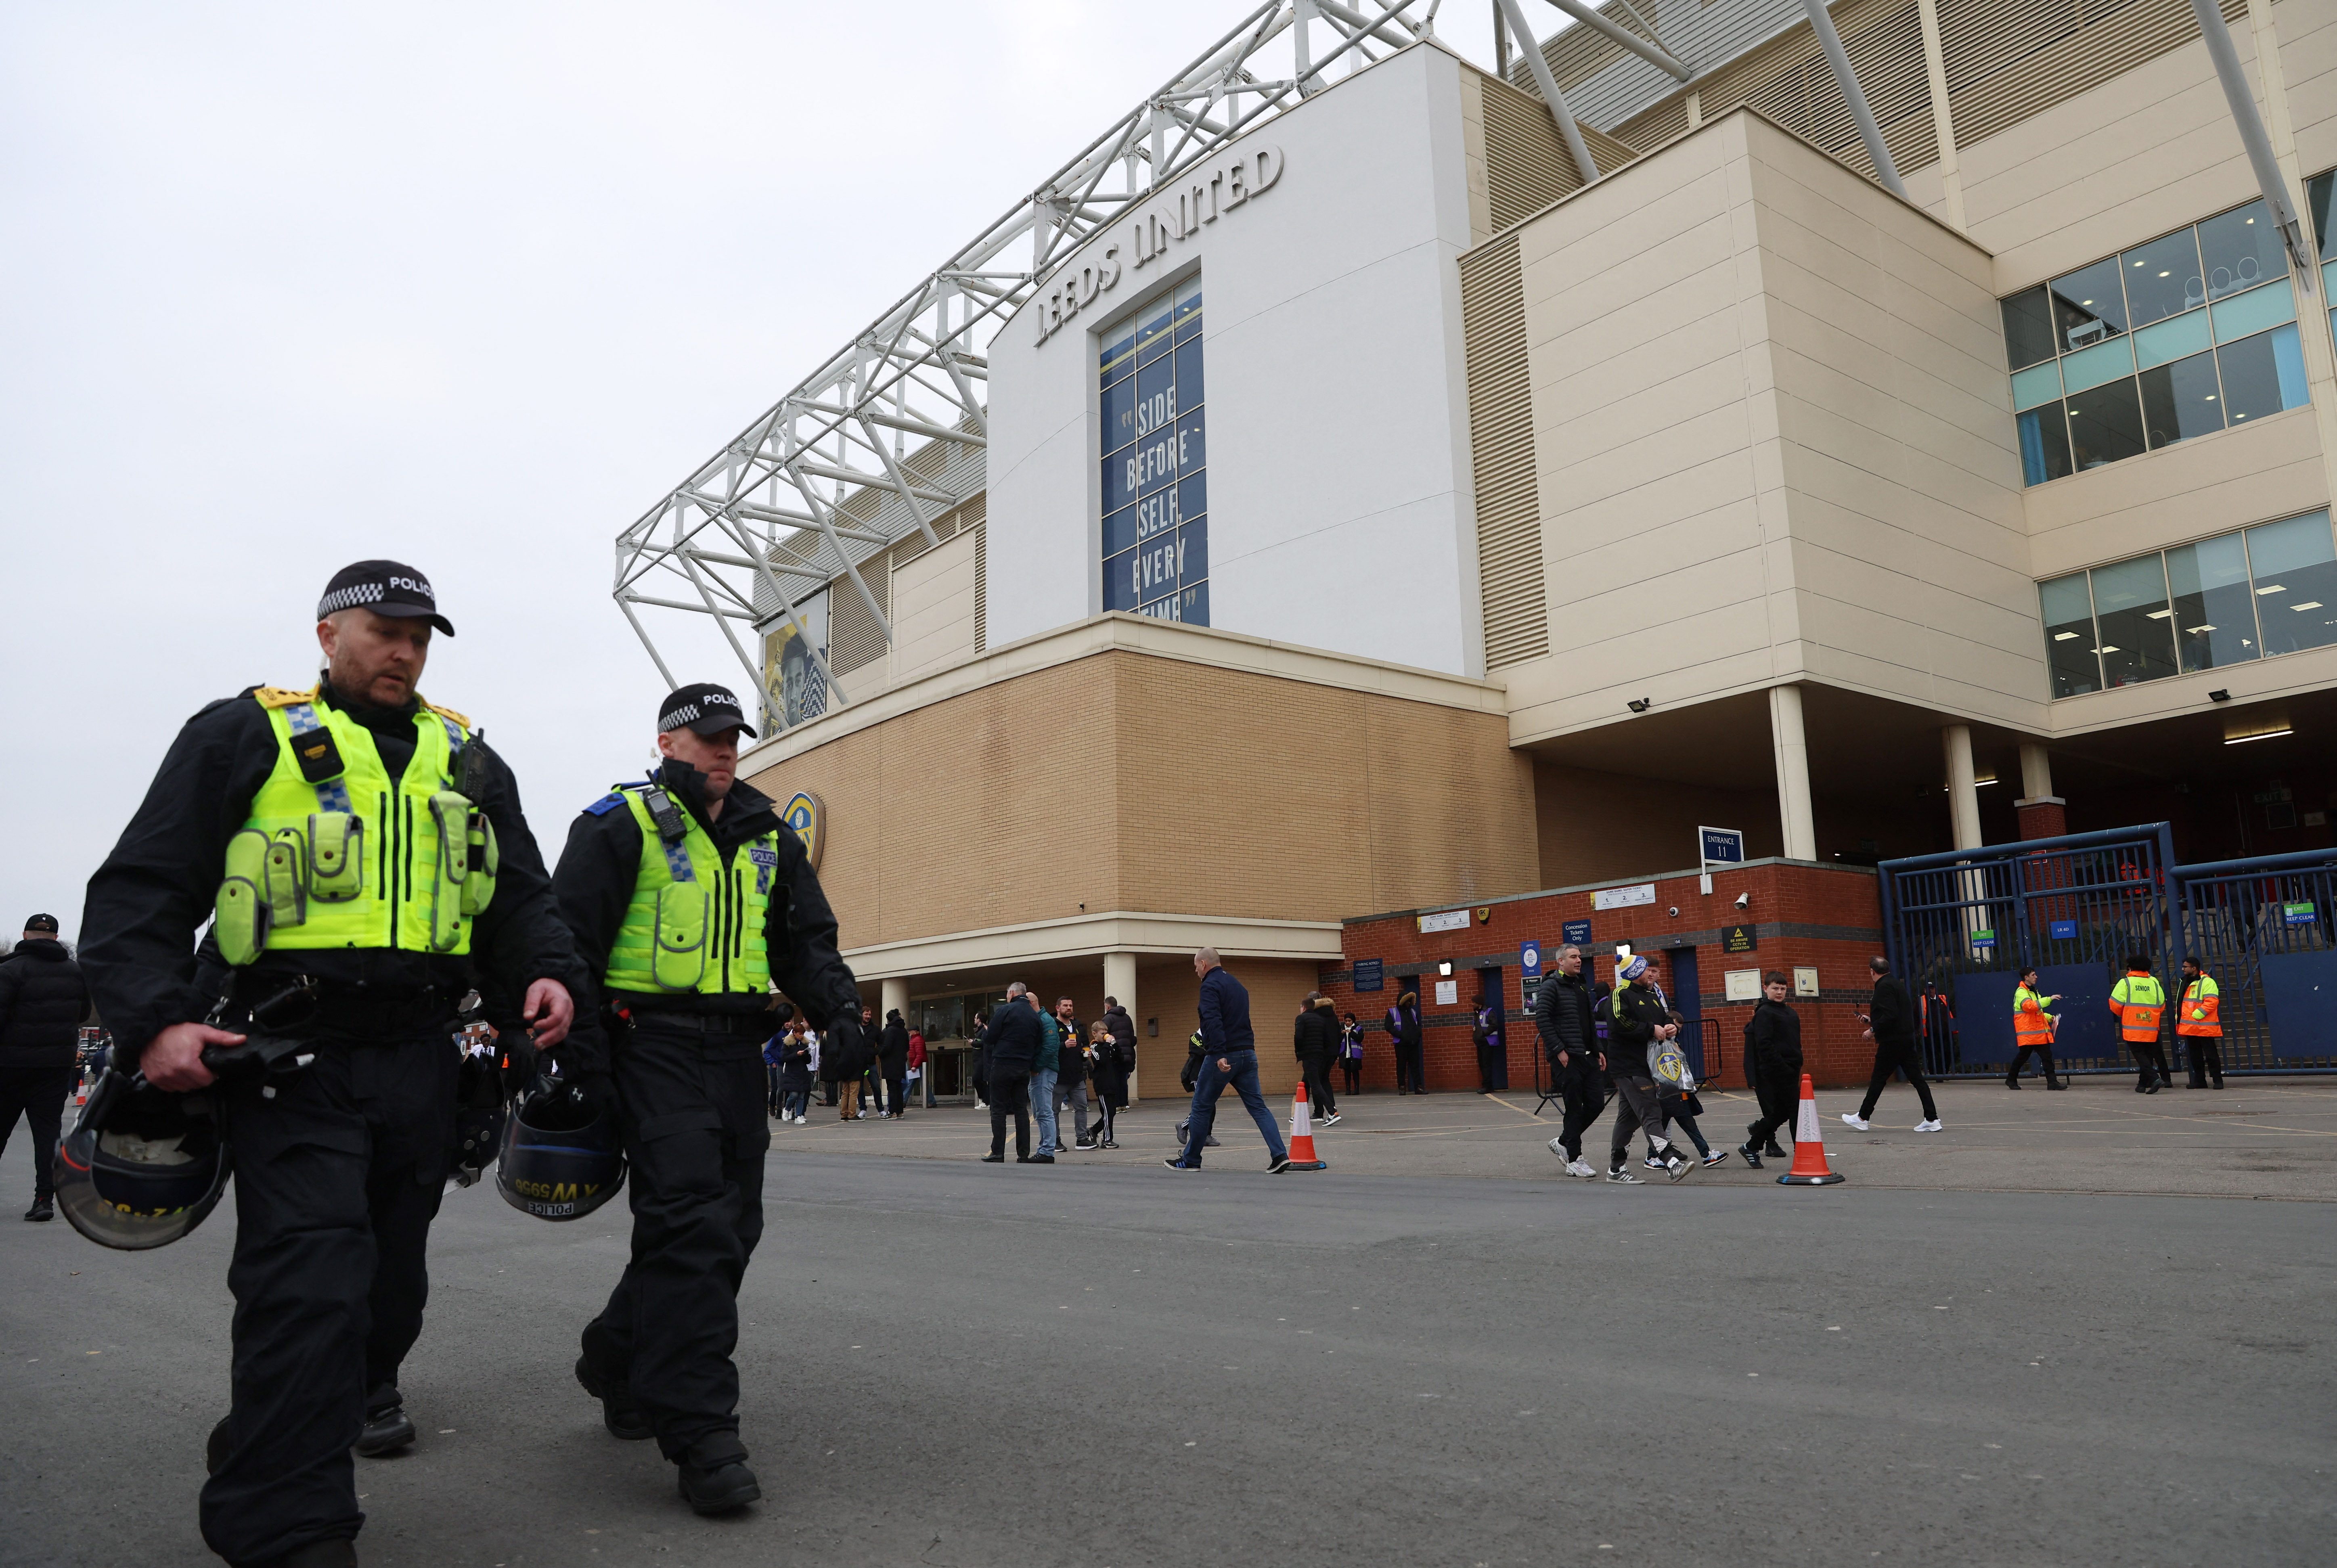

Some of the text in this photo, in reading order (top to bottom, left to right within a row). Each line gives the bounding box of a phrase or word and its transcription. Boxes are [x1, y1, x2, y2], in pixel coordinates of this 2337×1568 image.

[1033, 143, 1284, 348] LEEDS UNITED
[1127, 429, 1188, 492] BEFORE
[1133, 537, 1187, 593] EVERY
[2254, 791, 2279, 802] EXIT
[1708, 835, 1734, 845] ENTRANCE
[752, 851, 776, 863] POLICE
[1718, 846, 1726, 857] 11
[530, 1202, 572, 1214] POLICE
